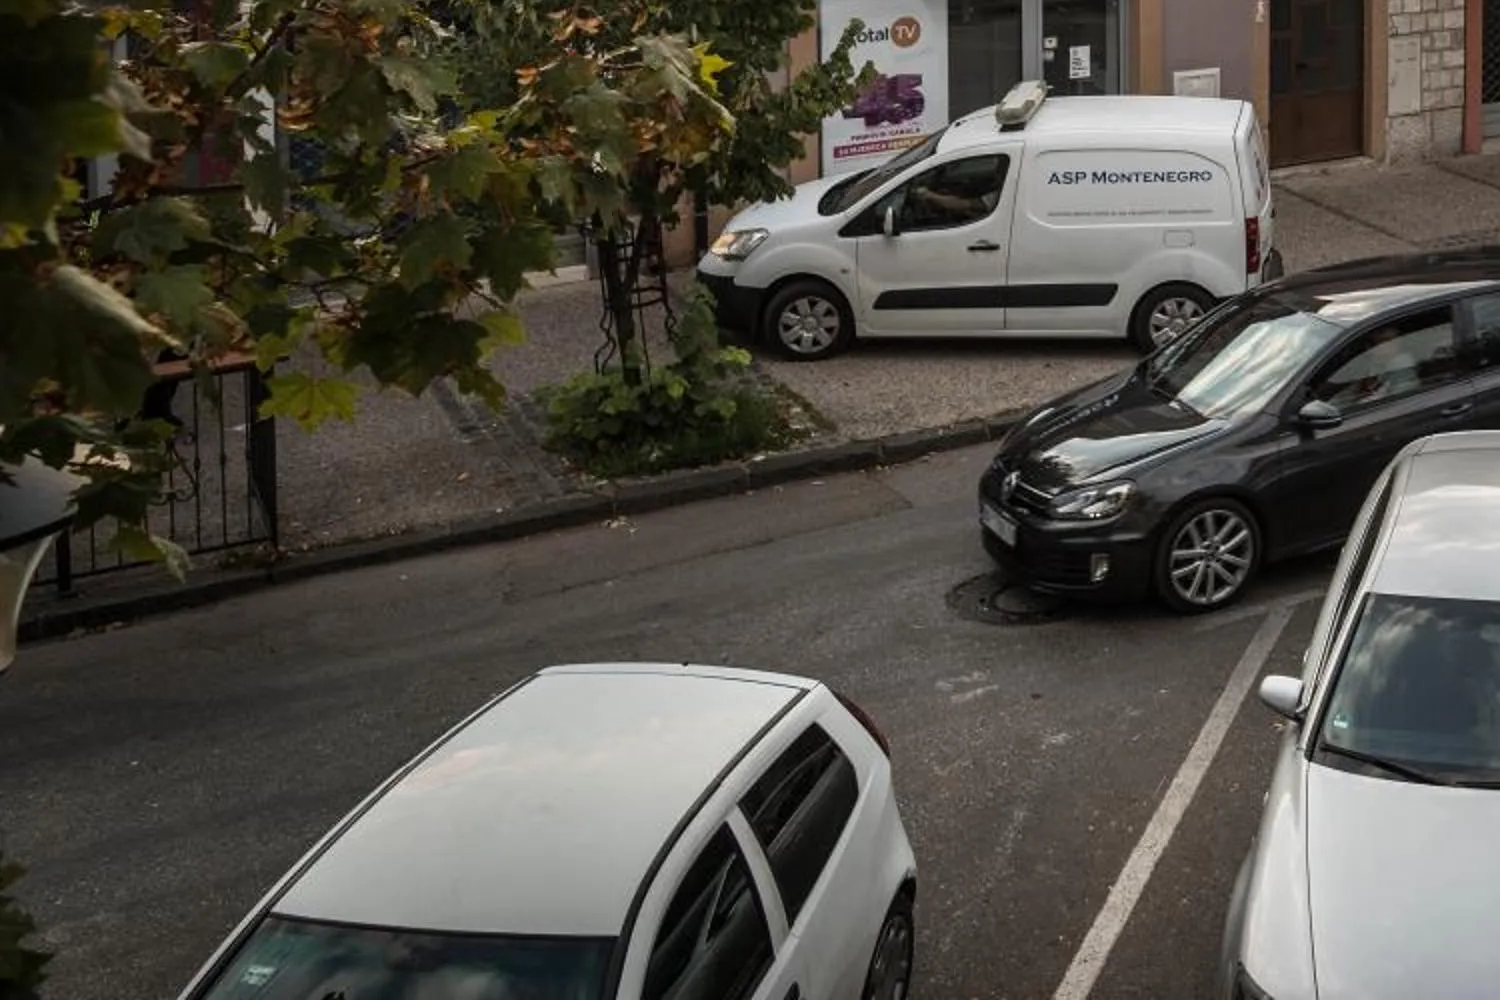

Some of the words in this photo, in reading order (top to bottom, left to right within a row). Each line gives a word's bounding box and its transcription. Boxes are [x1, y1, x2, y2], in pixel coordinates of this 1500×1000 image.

[856, 27, 889, 42] otal
[895, 23, 918, 40] TV
[1047, 171, 1087, 185] ASP
